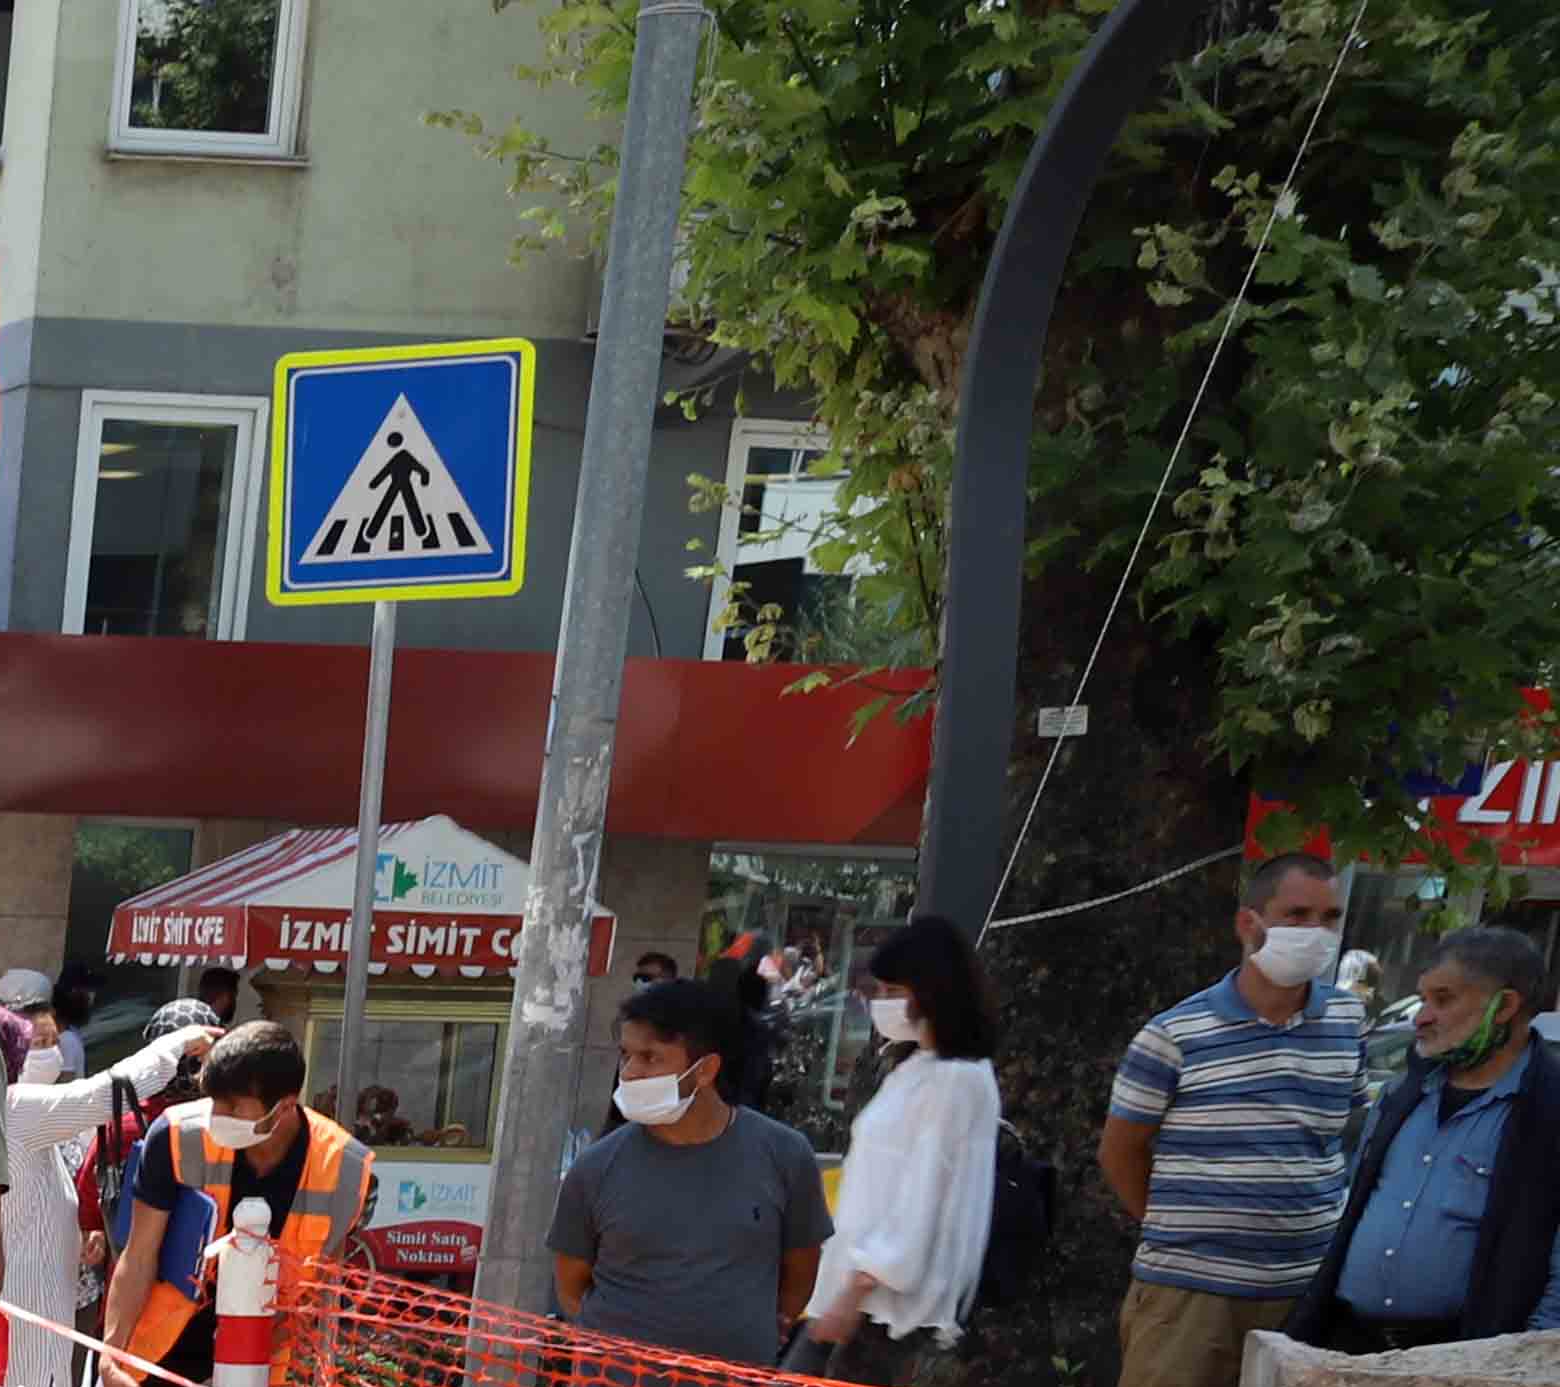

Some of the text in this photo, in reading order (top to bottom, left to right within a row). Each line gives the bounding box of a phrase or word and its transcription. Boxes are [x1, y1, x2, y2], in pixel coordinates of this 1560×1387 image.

[422, 856, 505, 890] İZMİT
[279, 914, 377, 951] İZMİ
[386, 919, 482, 957] SİMİT
[386, 1231, 468, 1247] Simit Satış
[396, 1247, 456, 1264] Noktası
